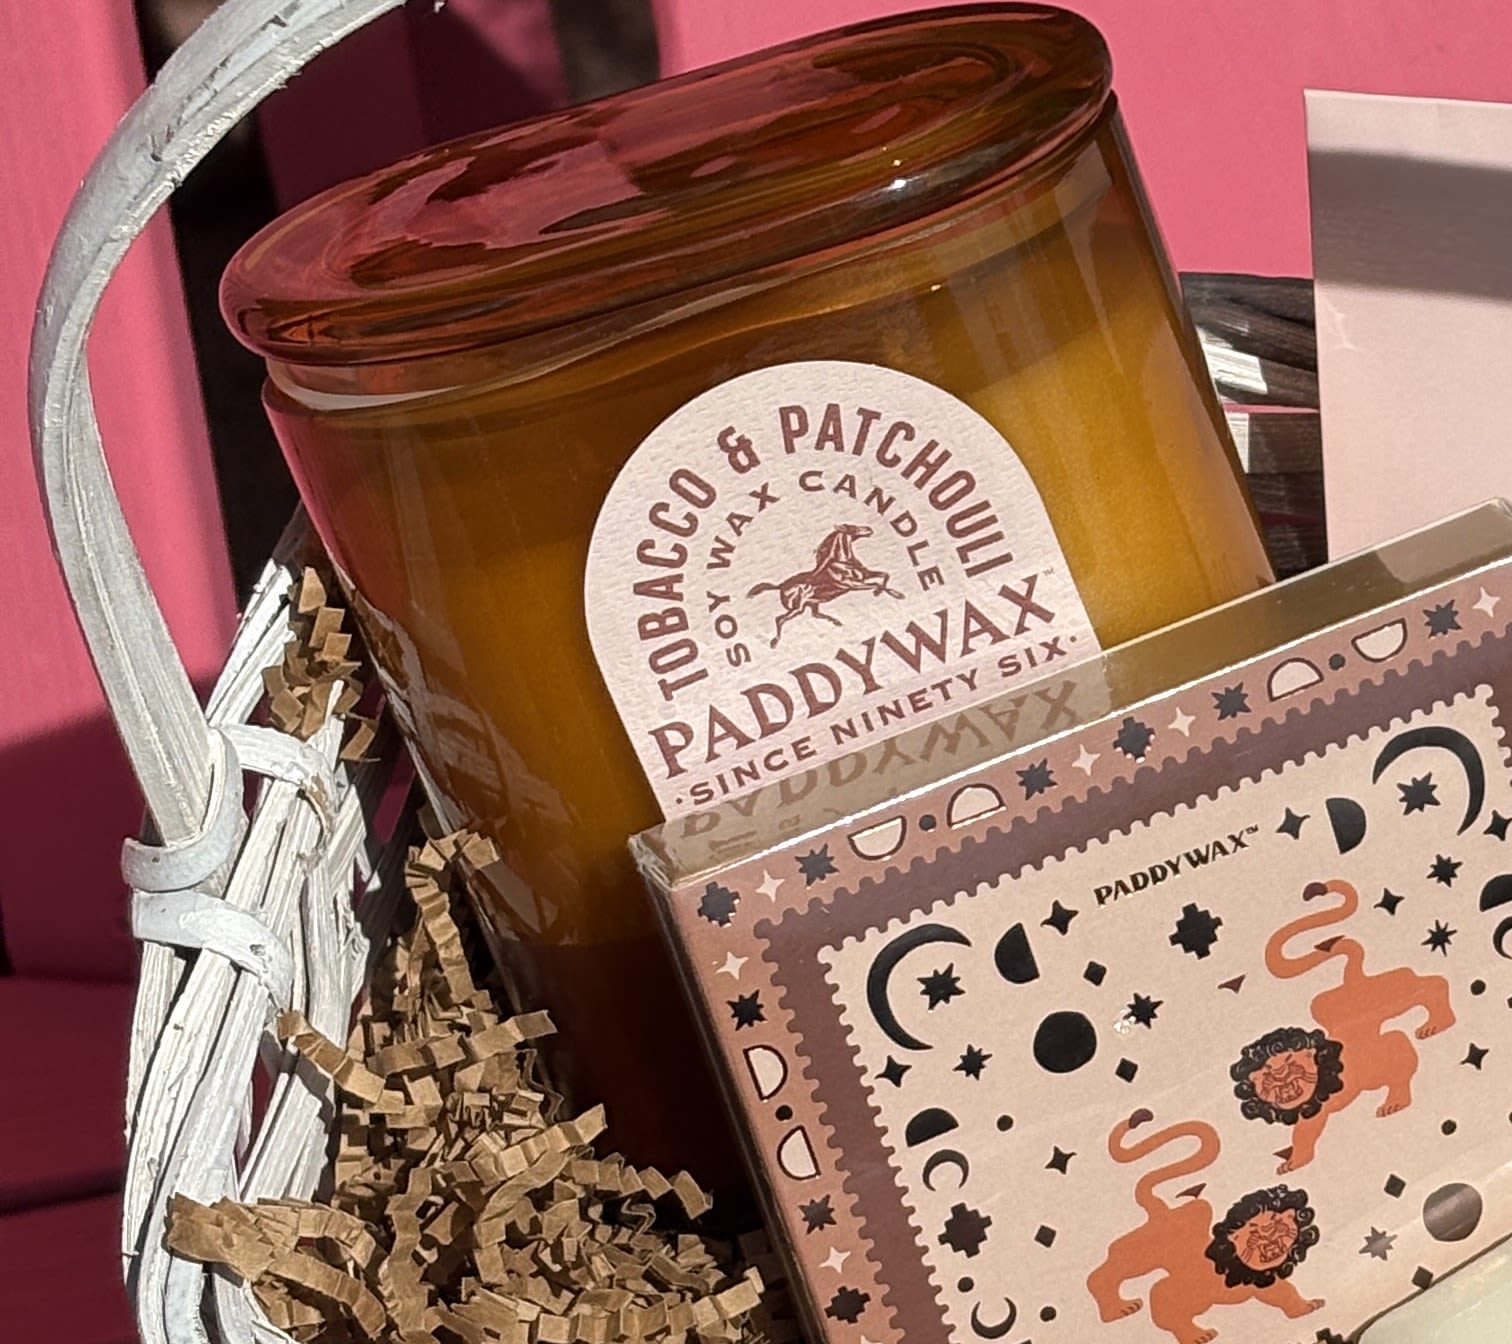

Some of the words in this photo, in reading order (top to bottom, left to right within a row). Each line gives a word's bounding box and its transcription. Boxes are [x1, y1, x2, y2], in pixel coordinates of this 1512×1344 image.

[633, 467, 718, 702] TOBACCO
[718, 425, 761, 474] &
[779, 403, 1014, 578] PATCHOULI
[707, 482, 780, 570] WAX
[799, 470, 944, 591] CANDLE
[707, 590, 752, 667] SOY
[831, 668, 981, 742] NINETY
